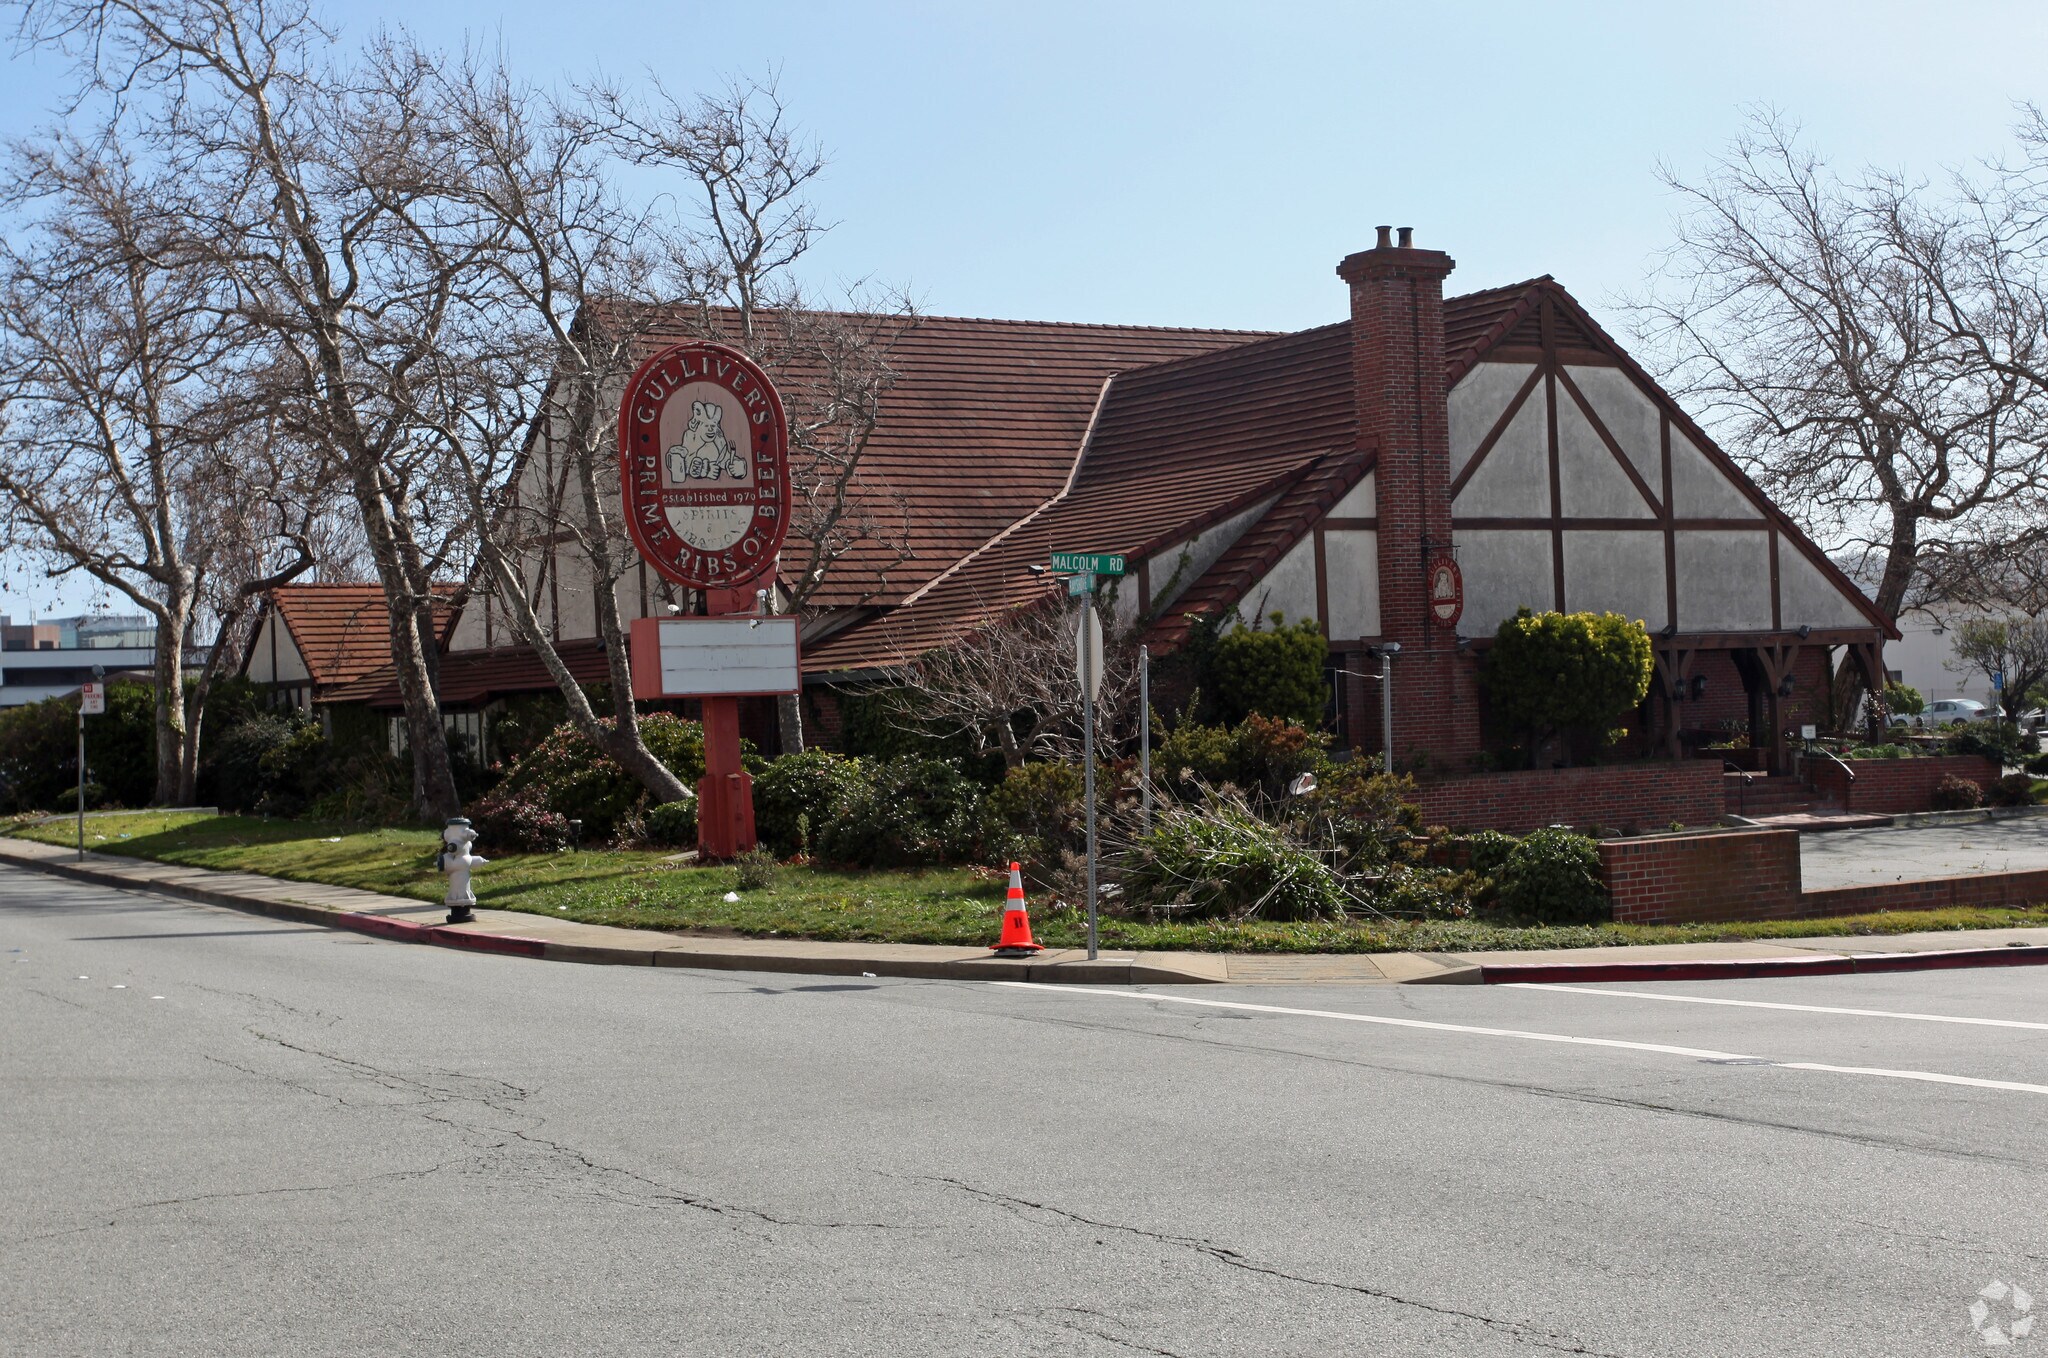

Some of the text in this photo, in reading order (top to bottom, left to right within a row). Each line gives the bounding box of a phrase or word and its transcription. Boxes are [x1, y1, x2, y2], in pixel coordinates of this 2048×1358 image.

[637, 357, 769, 424] GULLIVER'S
[662, 491, 756, 503] established 1970
[638, 455, 671, 546] PRIME
[674, 548, 737, 576] RIBS
[757, 451, 777, 518] BEEF
[674, 520, 746, 549] LIBAOS
[1052, 555, 1123, 571] MALCOLM RD
